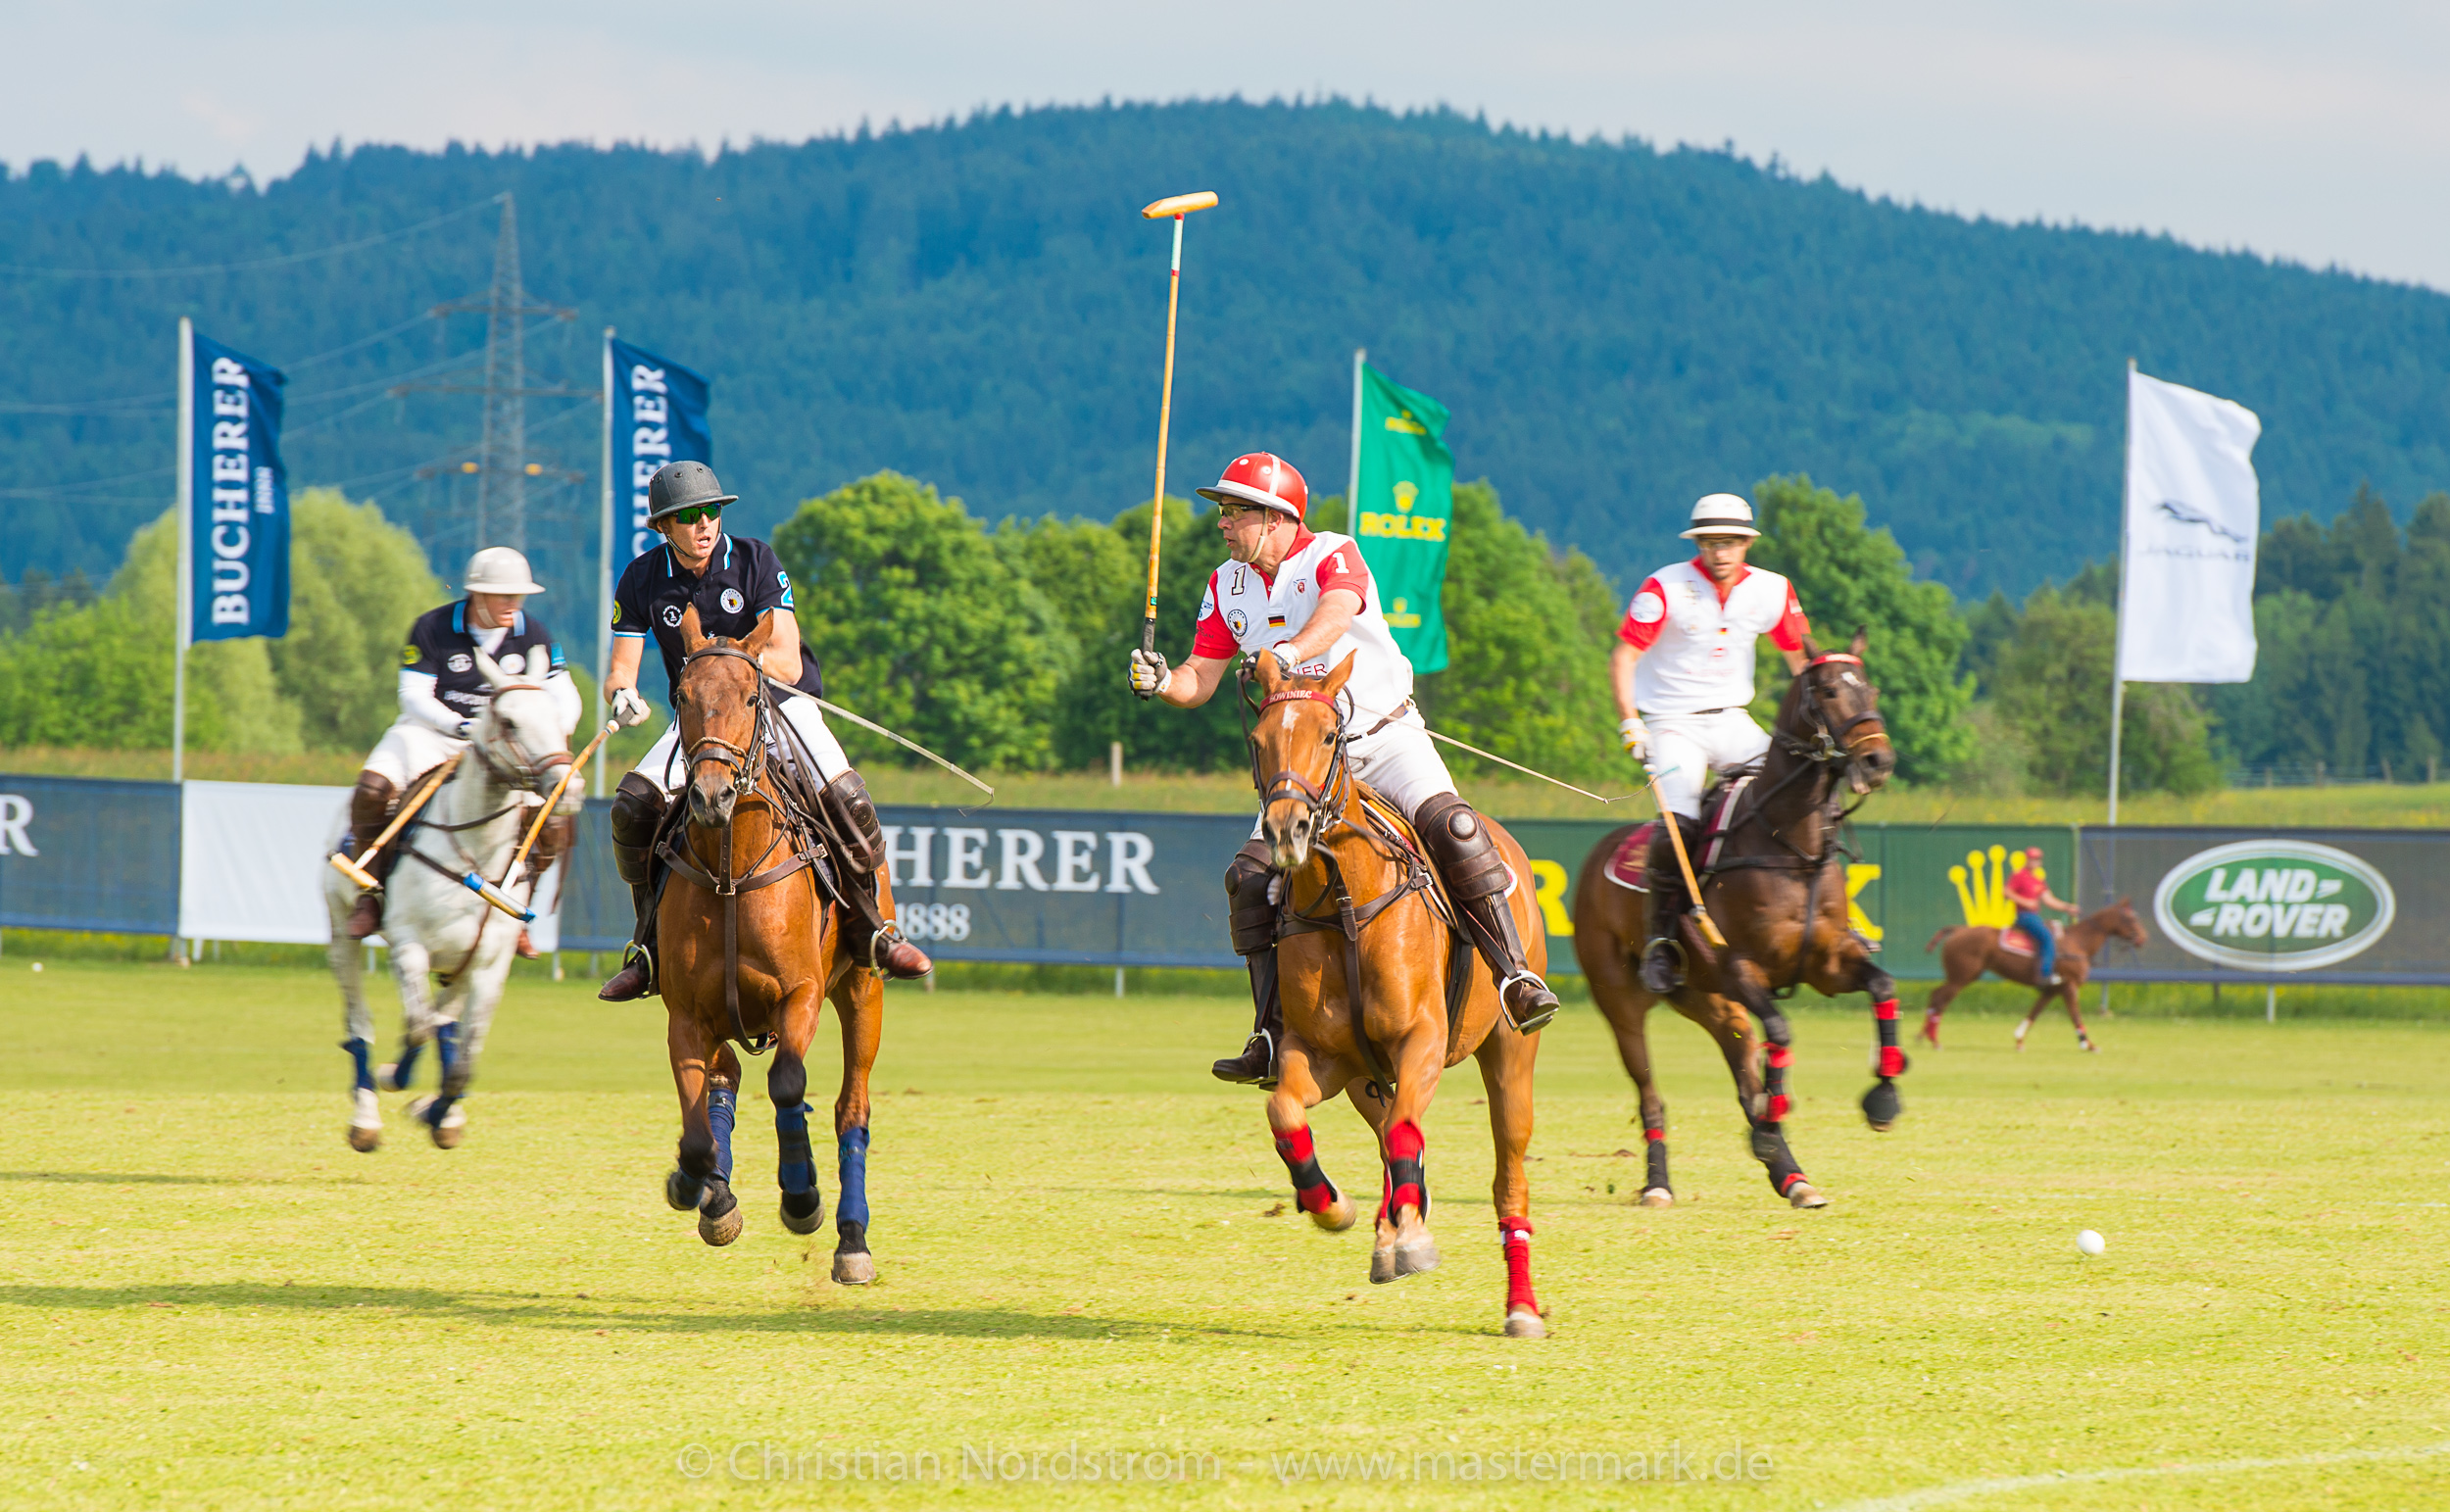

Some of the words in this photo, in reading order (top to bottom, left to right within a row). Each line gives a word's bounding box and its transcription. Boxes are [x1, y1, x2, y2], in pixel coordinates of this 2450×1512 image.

[212, 357, 250, 624] BUCHERER
[1359, 512, 1446, 542] ROLEX
[1332, 552, 1350, 574] 1
[776, 570, 795, 608] 2
[1232, 565, 1246, 596] 1
